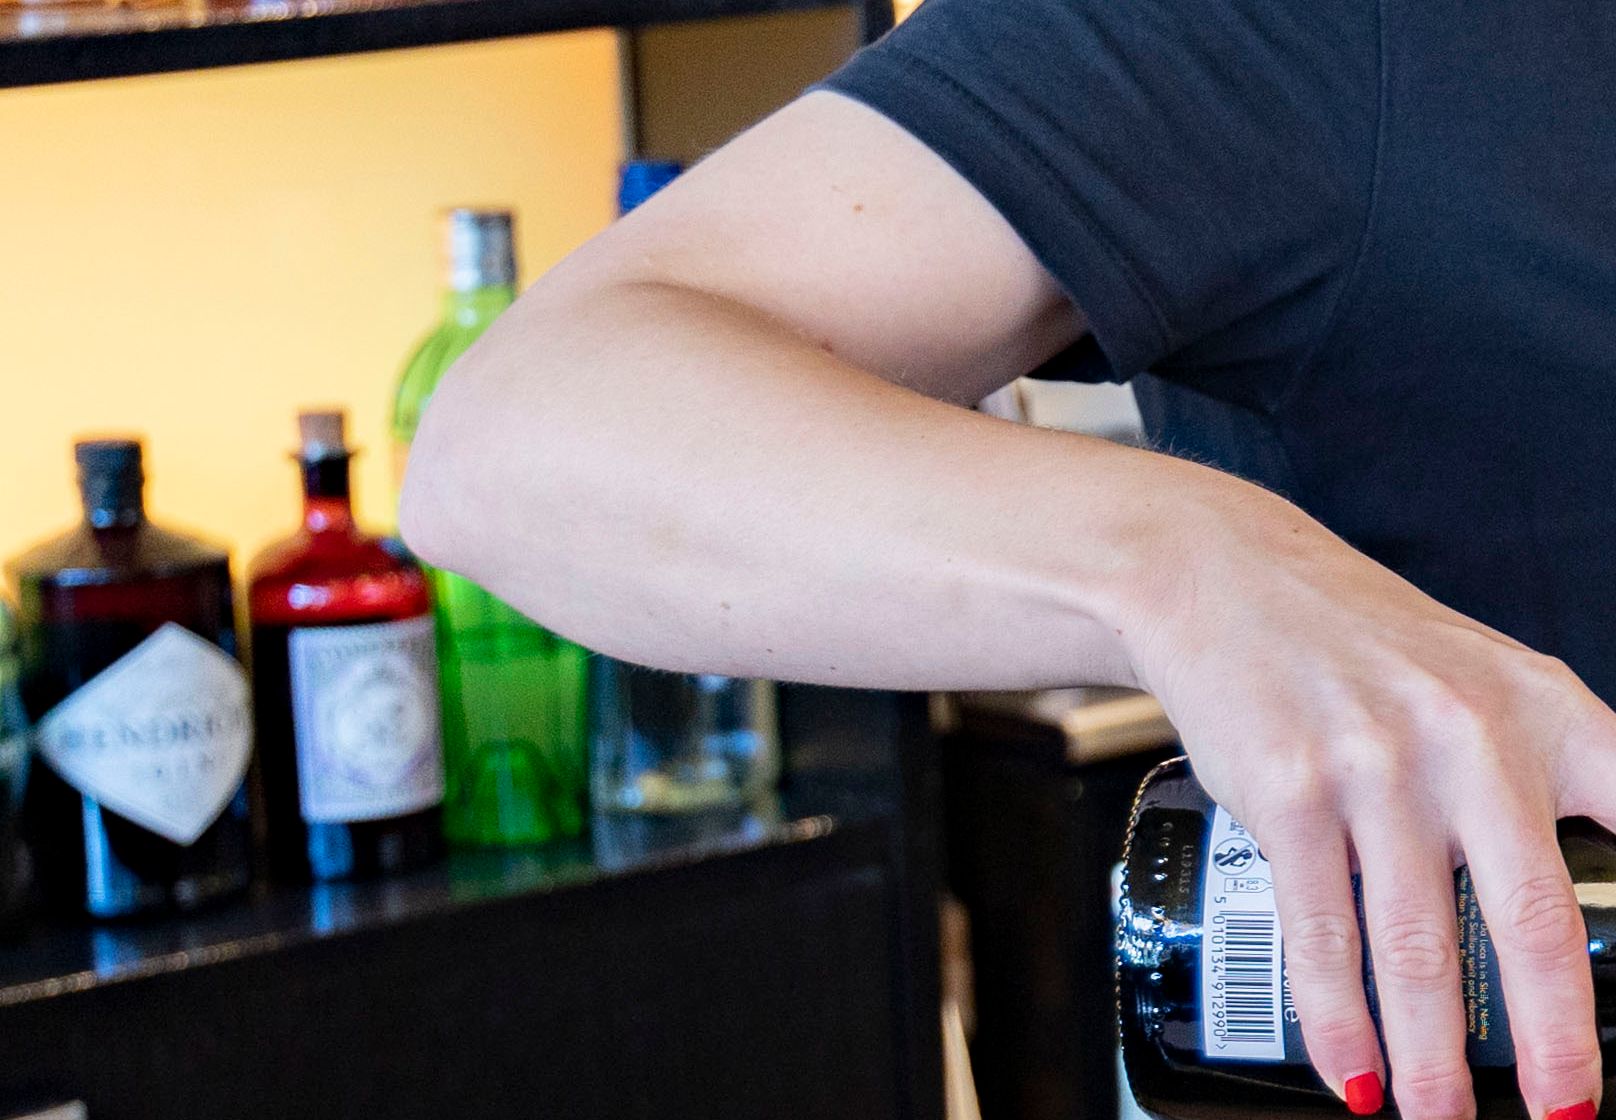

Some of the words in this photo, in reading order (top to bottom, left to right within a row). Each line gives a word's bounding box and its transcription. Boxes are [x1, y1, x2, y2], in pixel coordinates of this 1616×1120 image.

[1211, 915, 1227, 973] 010134
[1479, 939, 1489, 959] Luca
[1211, 982, 1227, 1037] 912990
